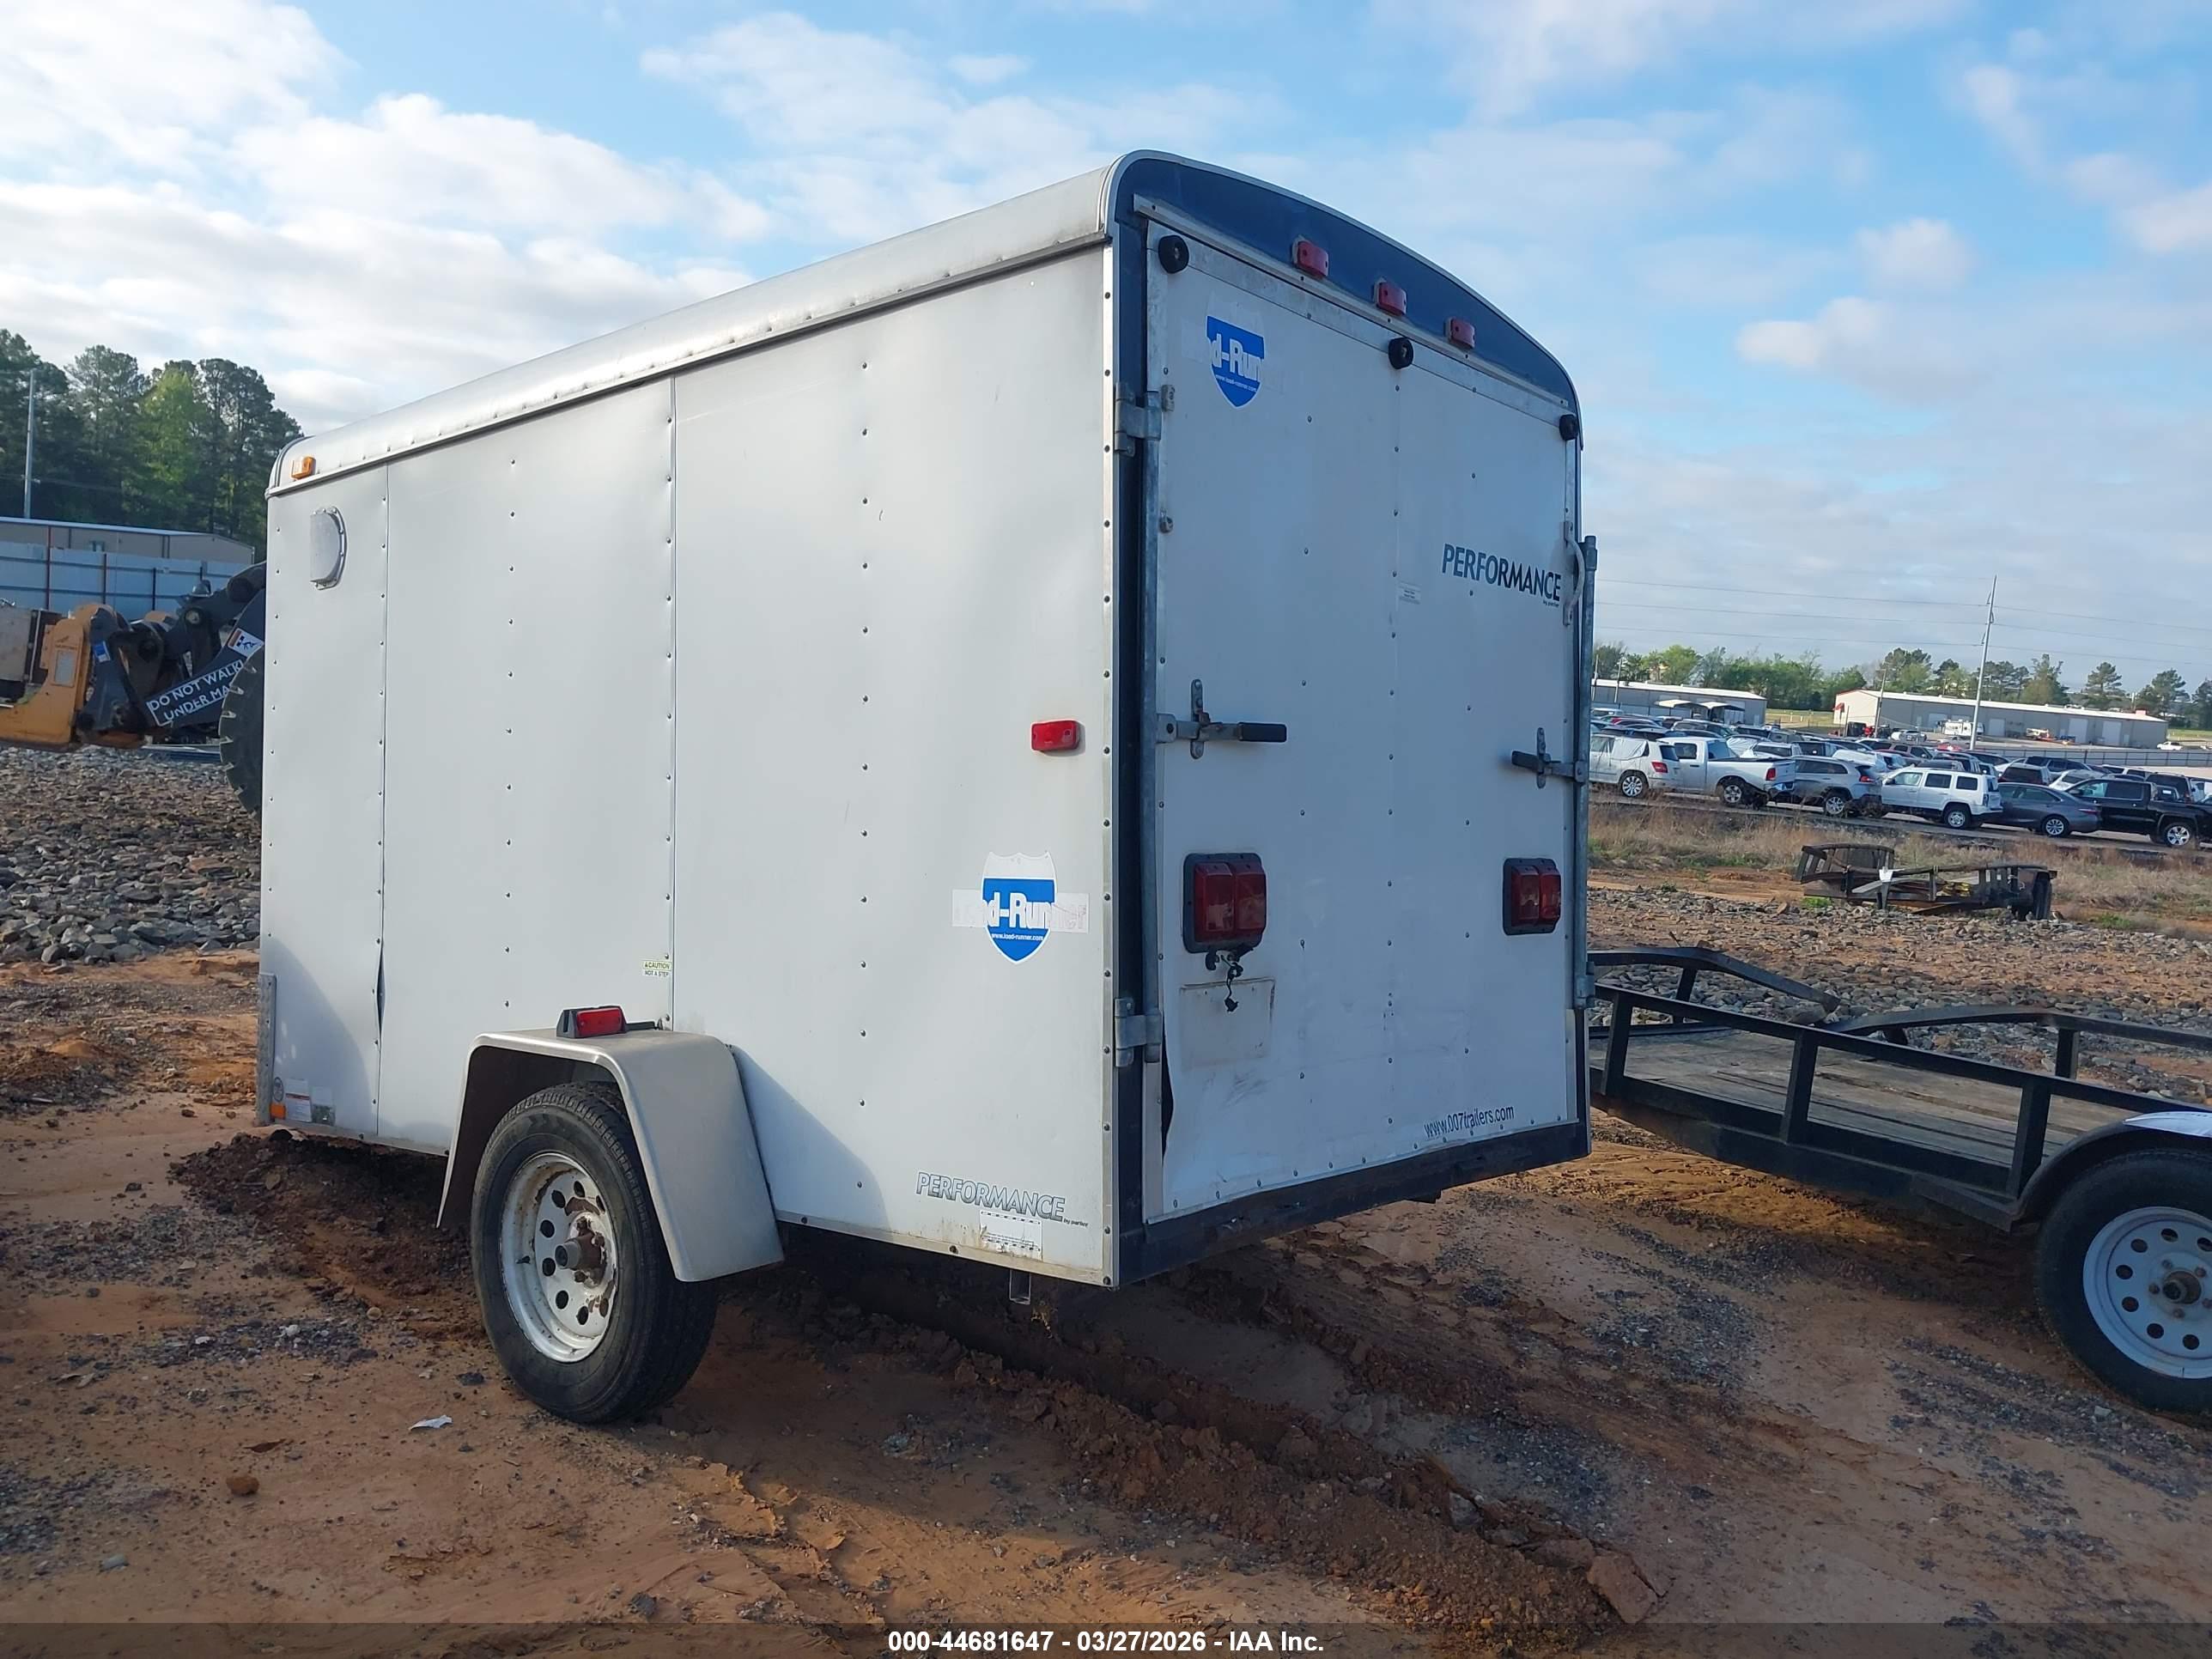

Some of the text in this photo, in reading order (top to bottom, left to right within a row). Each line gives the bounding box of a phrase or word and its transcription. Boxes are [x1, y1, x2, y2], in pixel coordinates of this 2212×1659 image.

[1442, 543, 1562, 602] PERFORMANCE
[149, 660, 243, 711] DO NOT WALK
[163, 695, 209, 721] UNDER
[1424, 1106, 1515, 1138] www.007trailers.com
[915, 1171, 1066, 1222] PERFORMANCE
